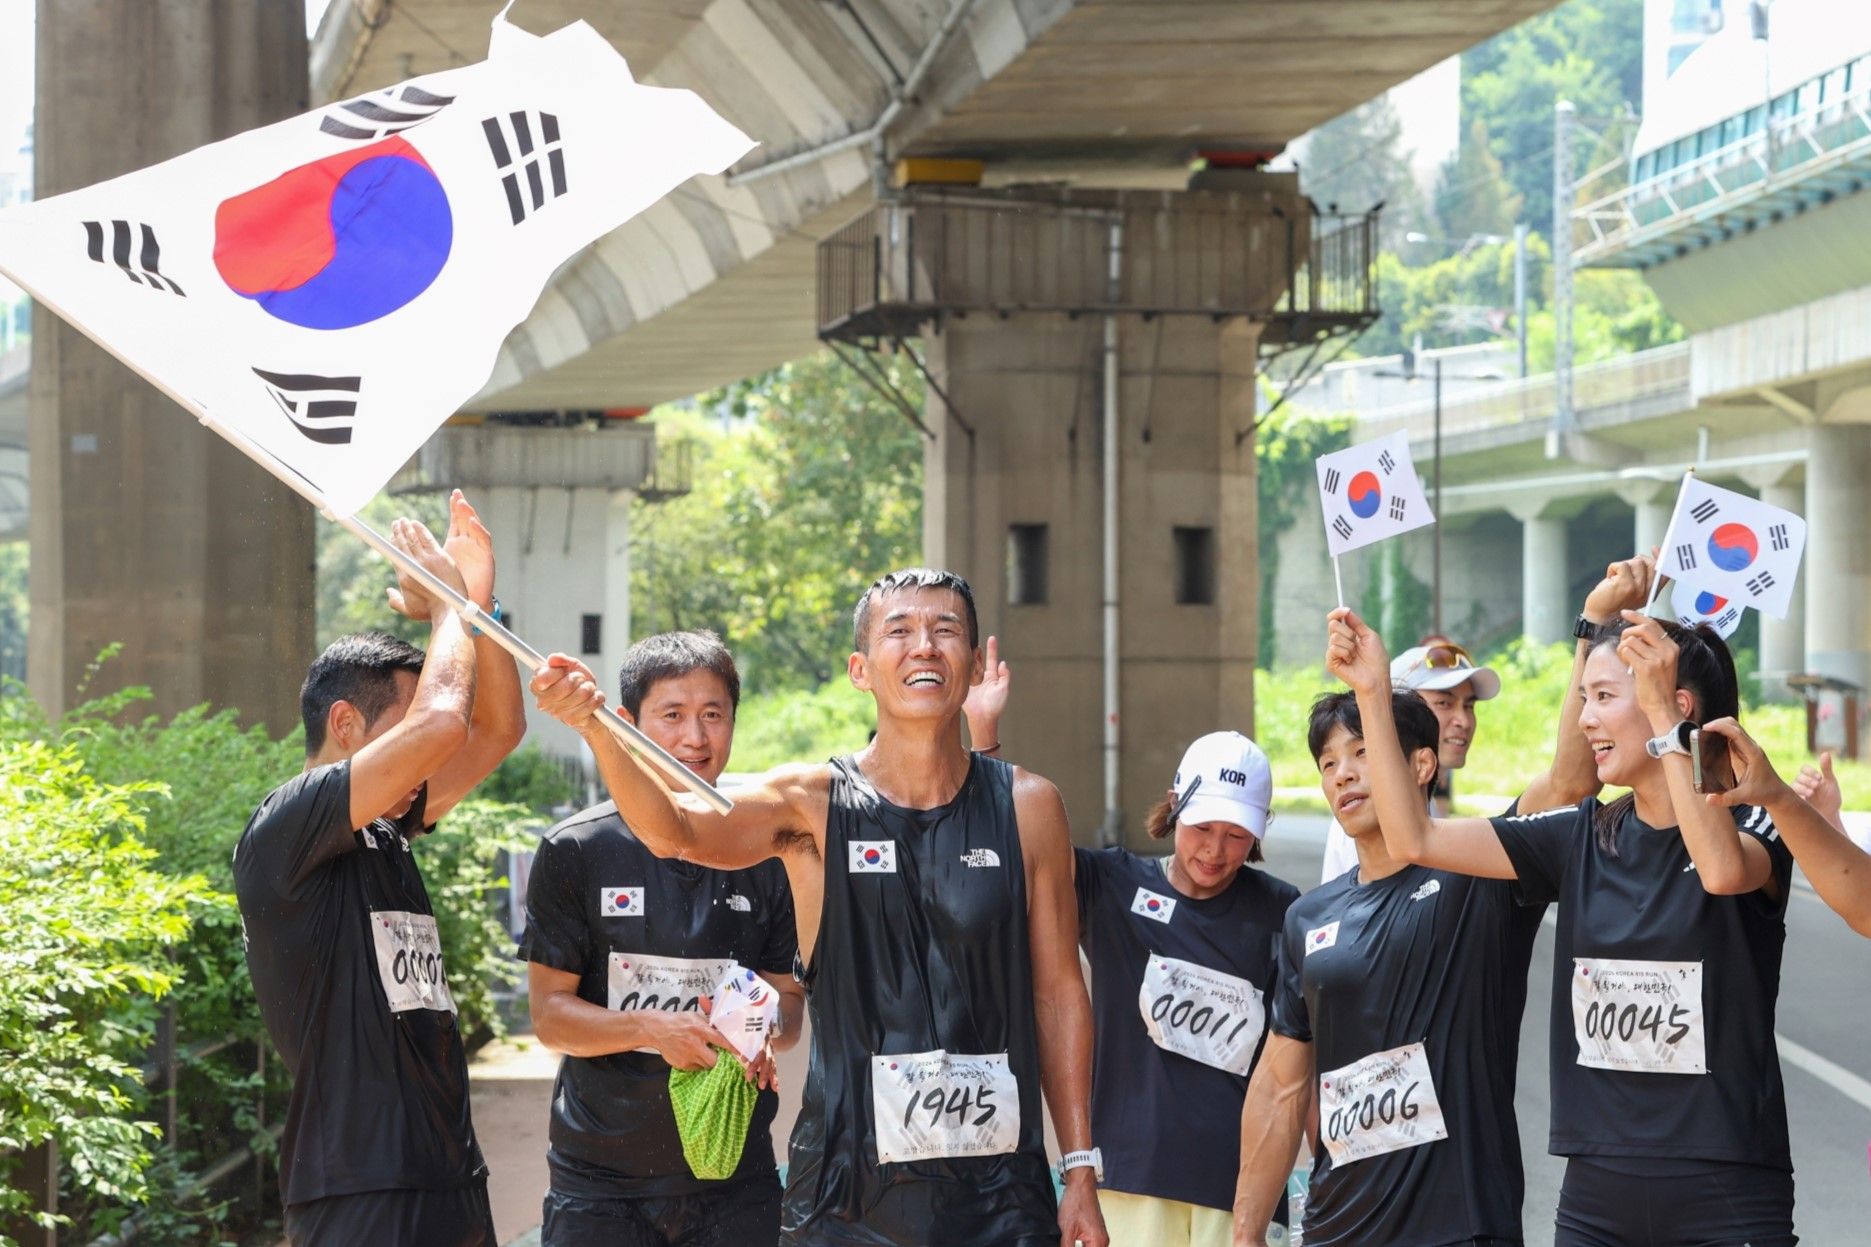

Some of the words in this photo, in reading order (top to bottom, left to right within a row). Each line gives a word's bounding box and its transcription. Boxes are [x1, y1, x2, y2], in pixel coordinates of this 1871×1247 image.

[1219, 768, 1246, 787] KOR
[1152, 994, 1248, 1044] 00011
[1586, 1001, 1690, 1045] 00045
[904, 1085, 997, 1129] 1945
[1328, 1081, 1419, 1142] 00006
